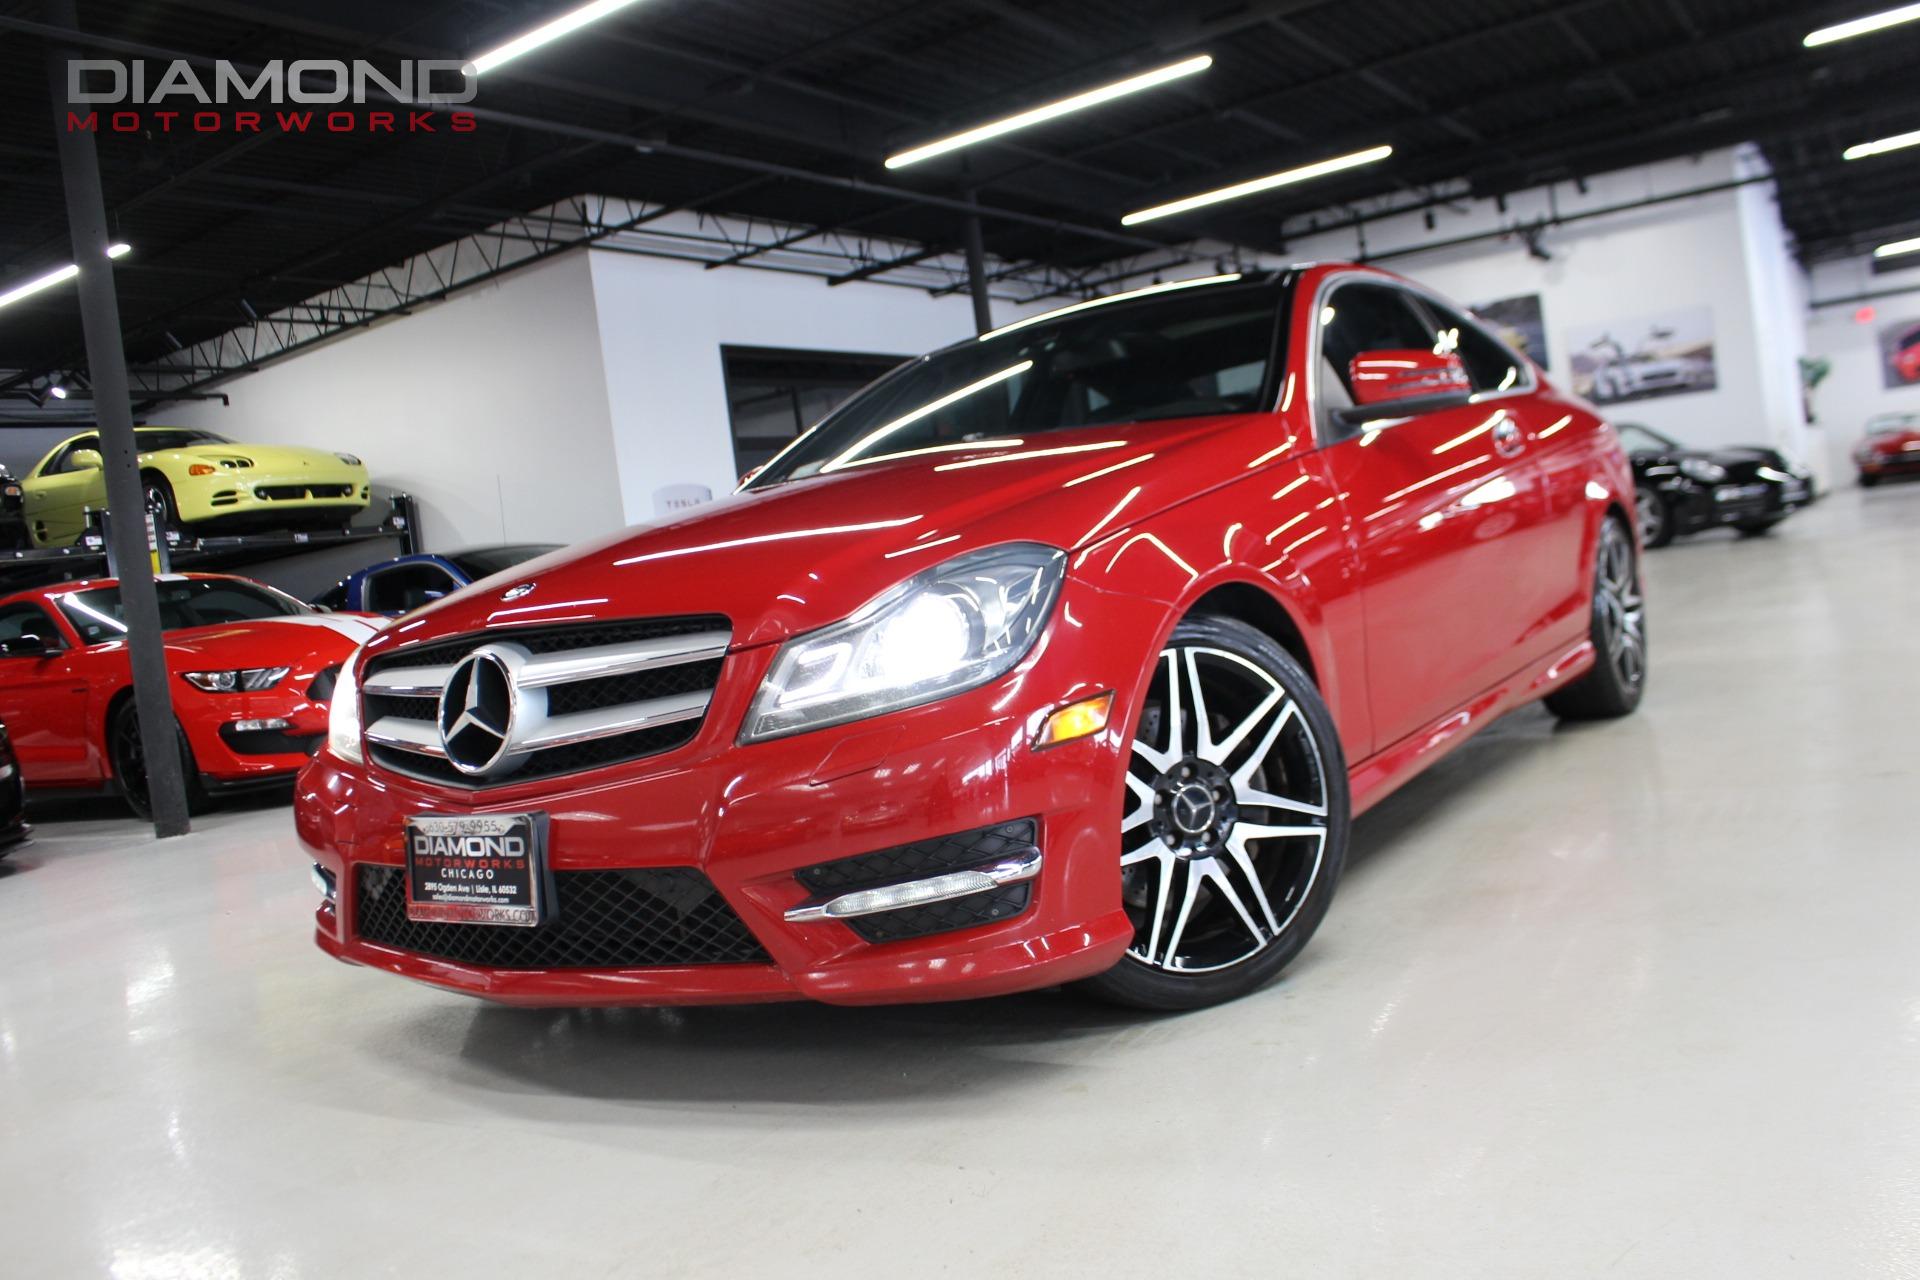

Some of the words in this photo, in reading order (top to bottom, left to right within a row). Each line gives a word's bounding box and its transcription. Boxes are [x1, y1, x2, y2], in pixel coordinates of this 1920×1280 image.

[666, 498, 700, 509] TESLA
[414, 835, 525, 857] DIAMOND
[415, 857, 525, 869] MOTORWORKS
[441, 867, 494, 880] CHICAGO
[438, 883, 457, 893] Ogden
[458, 884, 470, 893] Ave
